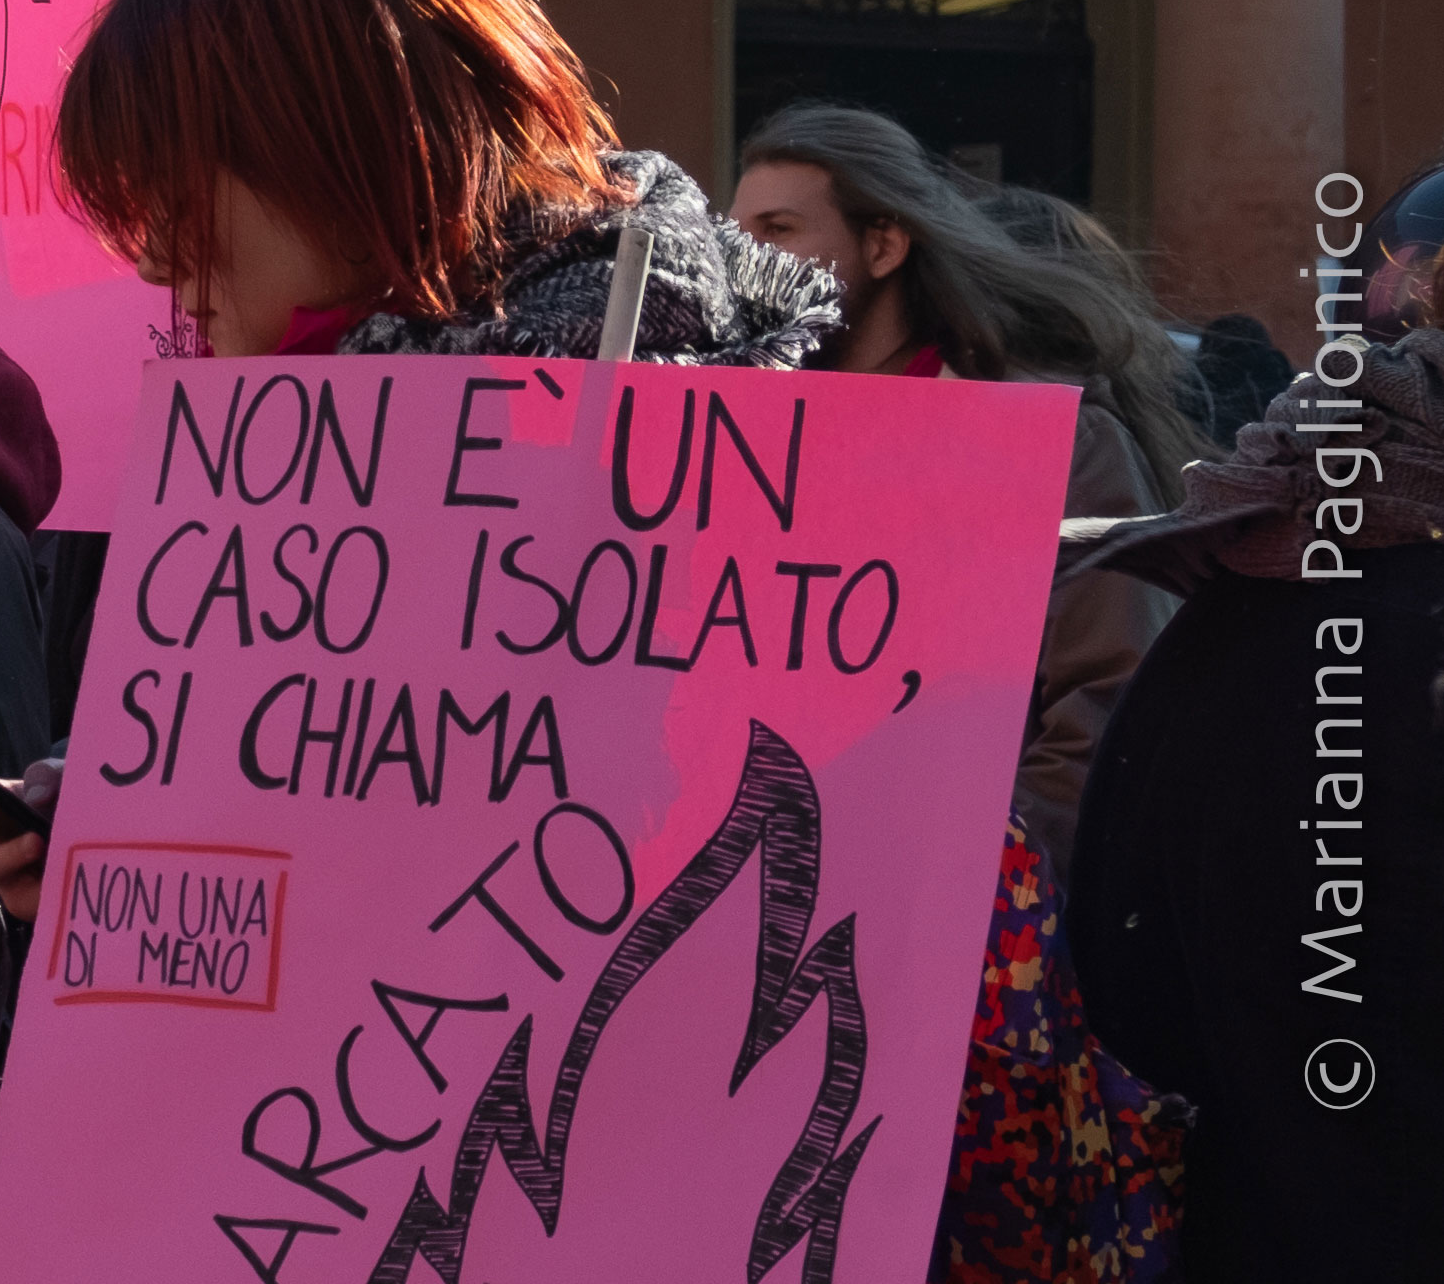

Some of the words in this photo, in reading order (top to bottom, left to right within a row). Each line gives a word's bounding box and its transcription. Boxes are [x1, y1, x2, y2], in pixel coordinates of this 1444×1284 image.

[155, 373, 392, 508] NON
[611, 385, 804, 533] UN
[137, 520, 390, 654] CASO
[459, 527, 923, 714] ISOLATO,
[99, 669, 192, 786] SI
[238, 672, 568, 806] CHIAMA
[65, 929, 98, 990] DI
[136, 933, 251, 996] MENO
[71, 859, 164, 930] NON
[176, 862, 270, 936] UNA
